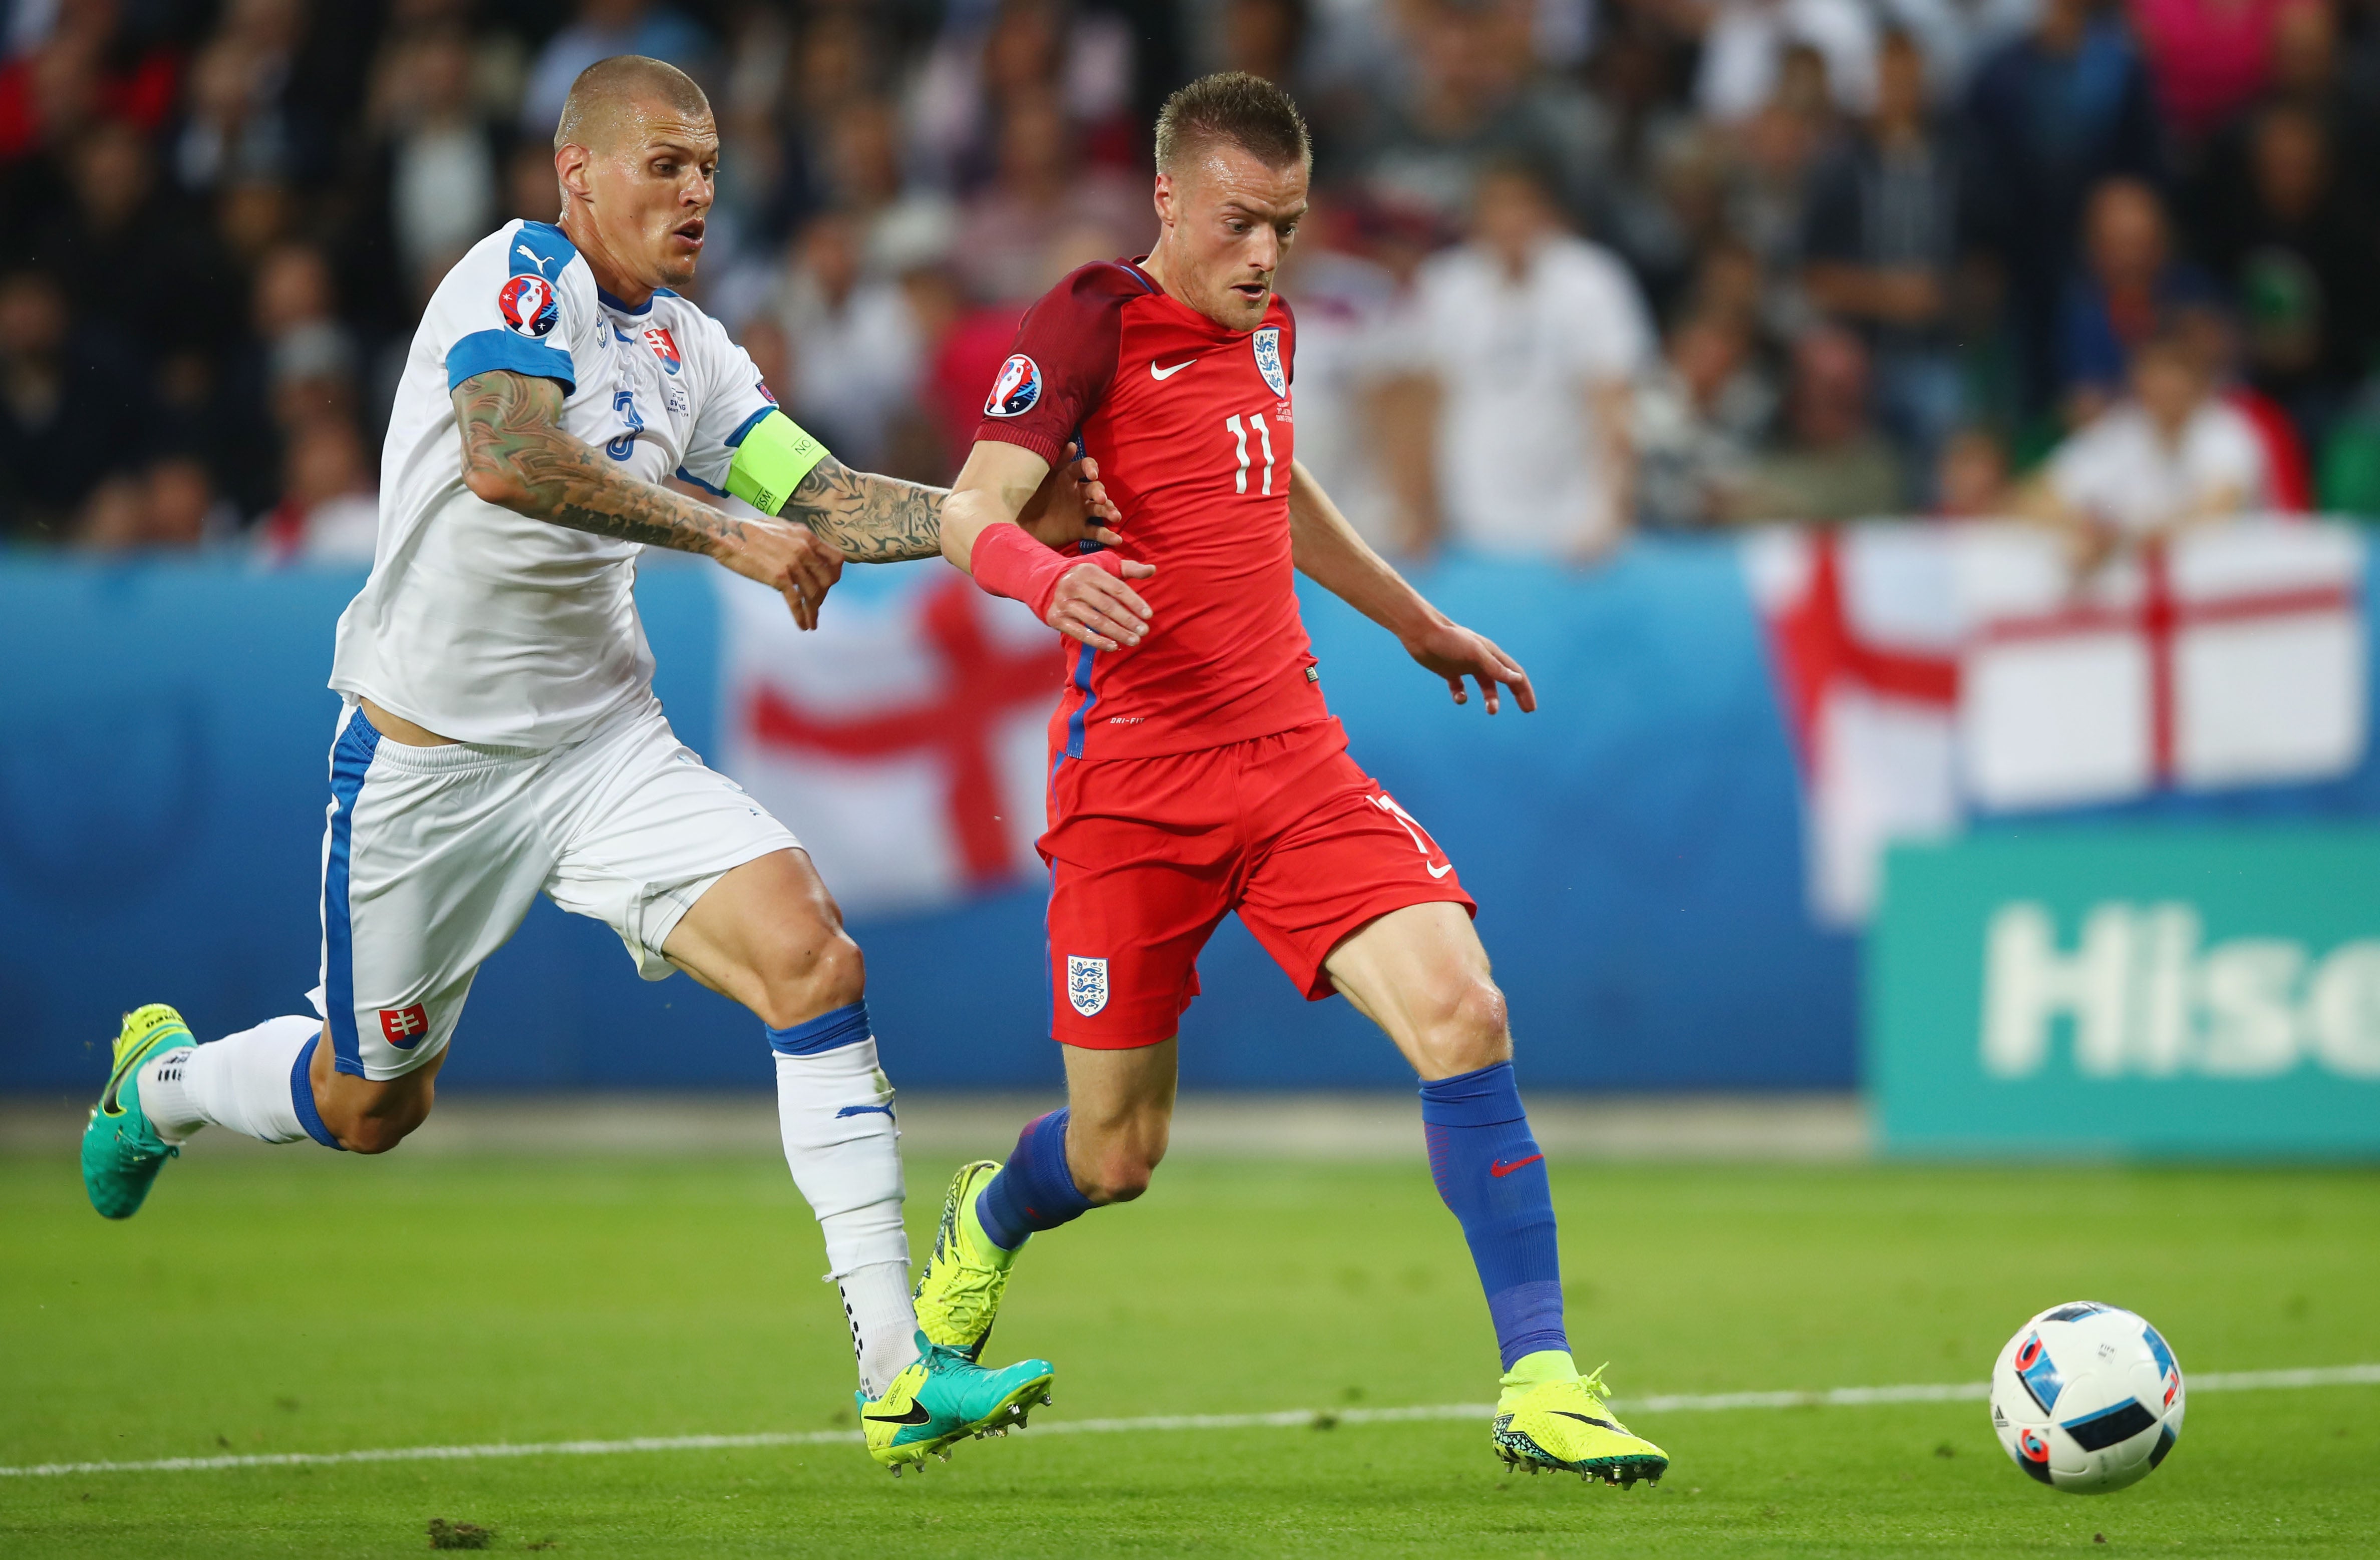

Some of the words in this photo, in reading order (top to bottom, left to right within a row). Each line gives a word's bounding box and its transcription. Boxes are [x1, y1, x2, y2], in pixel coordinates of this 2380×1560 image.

[606, 391, 644, 461] 3
[794, 439, 811, 455] NO
[1226, 413, 1275, 496] 11
[756, 490, 773, 510] CISM
